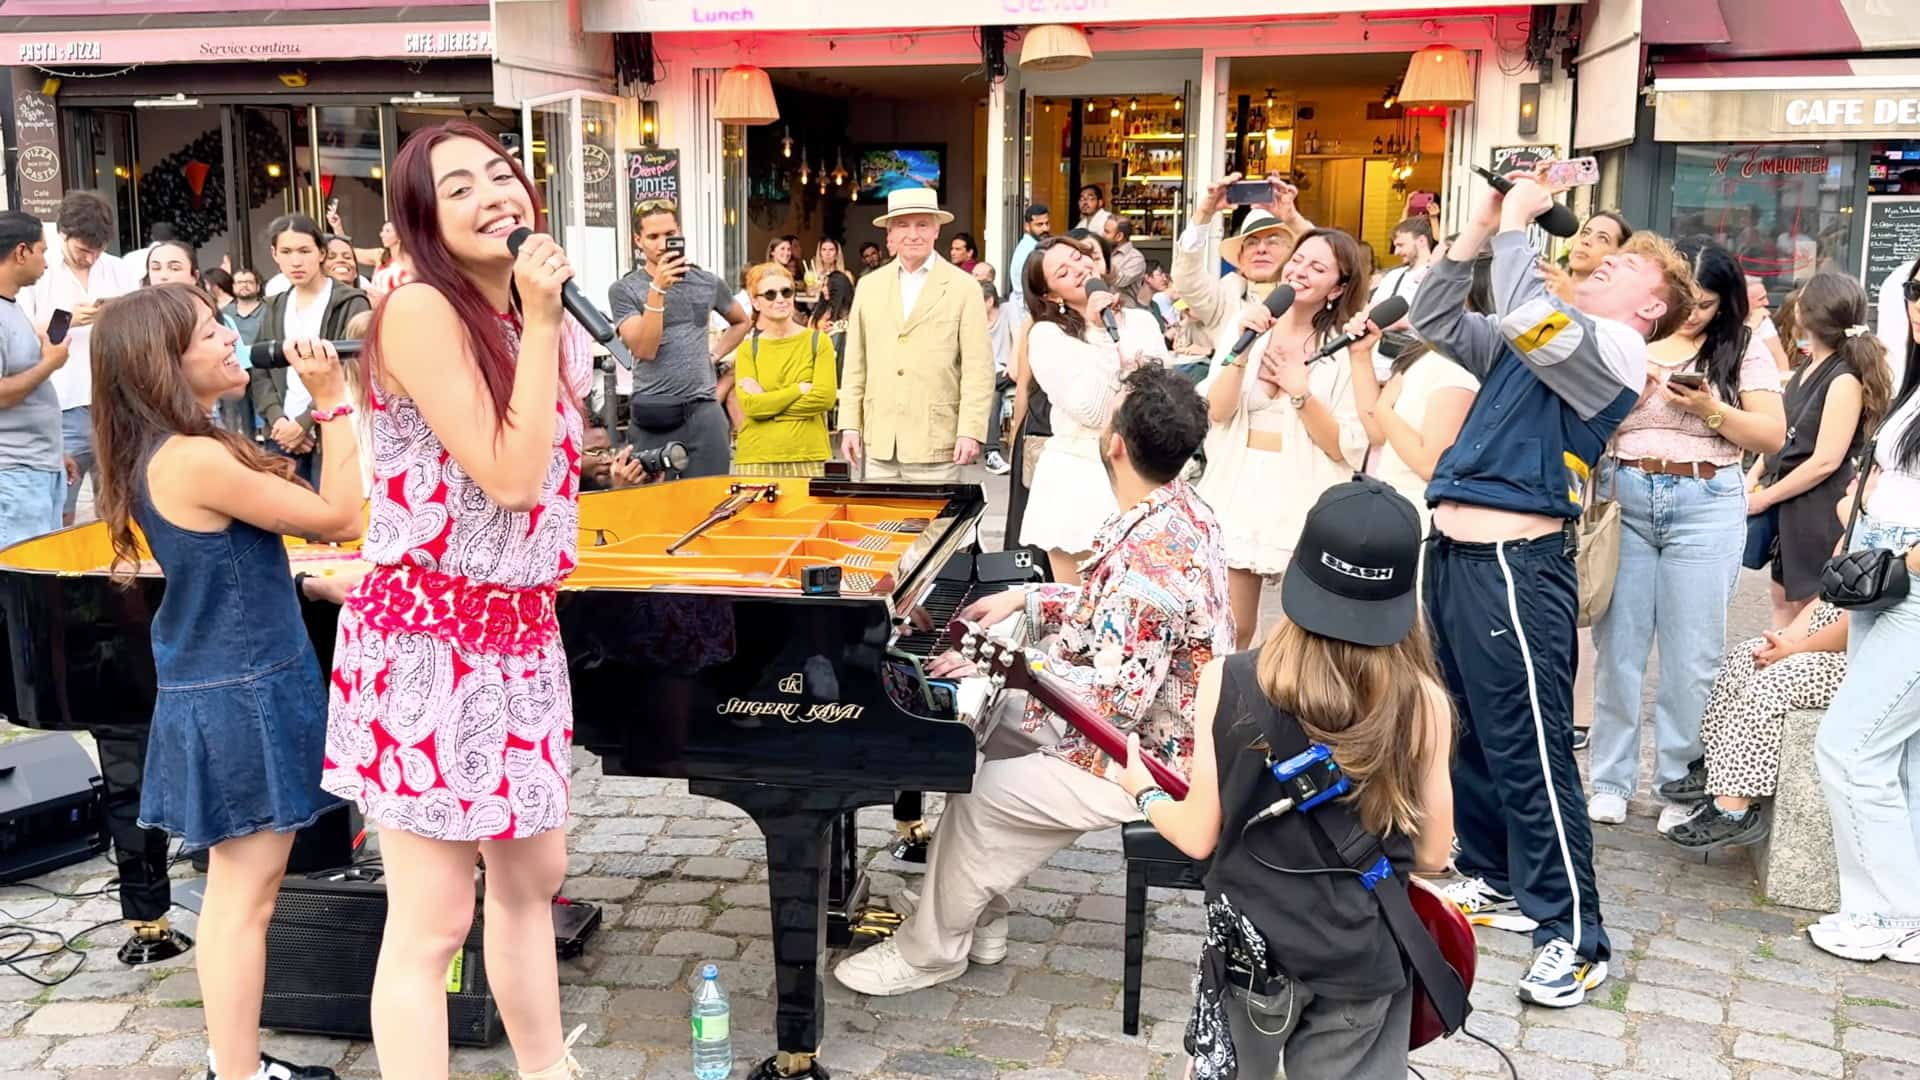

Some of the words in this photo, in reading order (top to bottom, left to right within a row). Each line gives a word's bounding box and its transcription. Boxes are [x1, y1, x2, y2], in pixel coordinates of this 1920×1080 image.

[692, 7, 754, 24] Lunch
[20, 43, 56, 61] PASTA
[67, 41, 102, 60] PIZZA
[199, 41, 248, 55] Service
[1785, 98, 1864, 126] CAFE
[1872, 98, 1920, 125] DE
[24, 148, 53, 161] PIZZA
[25, 167, 56, 180] PASTA
[635, 176, 676, 193] PINTES
[1323, 553, 1393, 579] SLASH
[716, 697, 800, 723] SHIGERU
[798, 703, 865, 723] KAWAI
